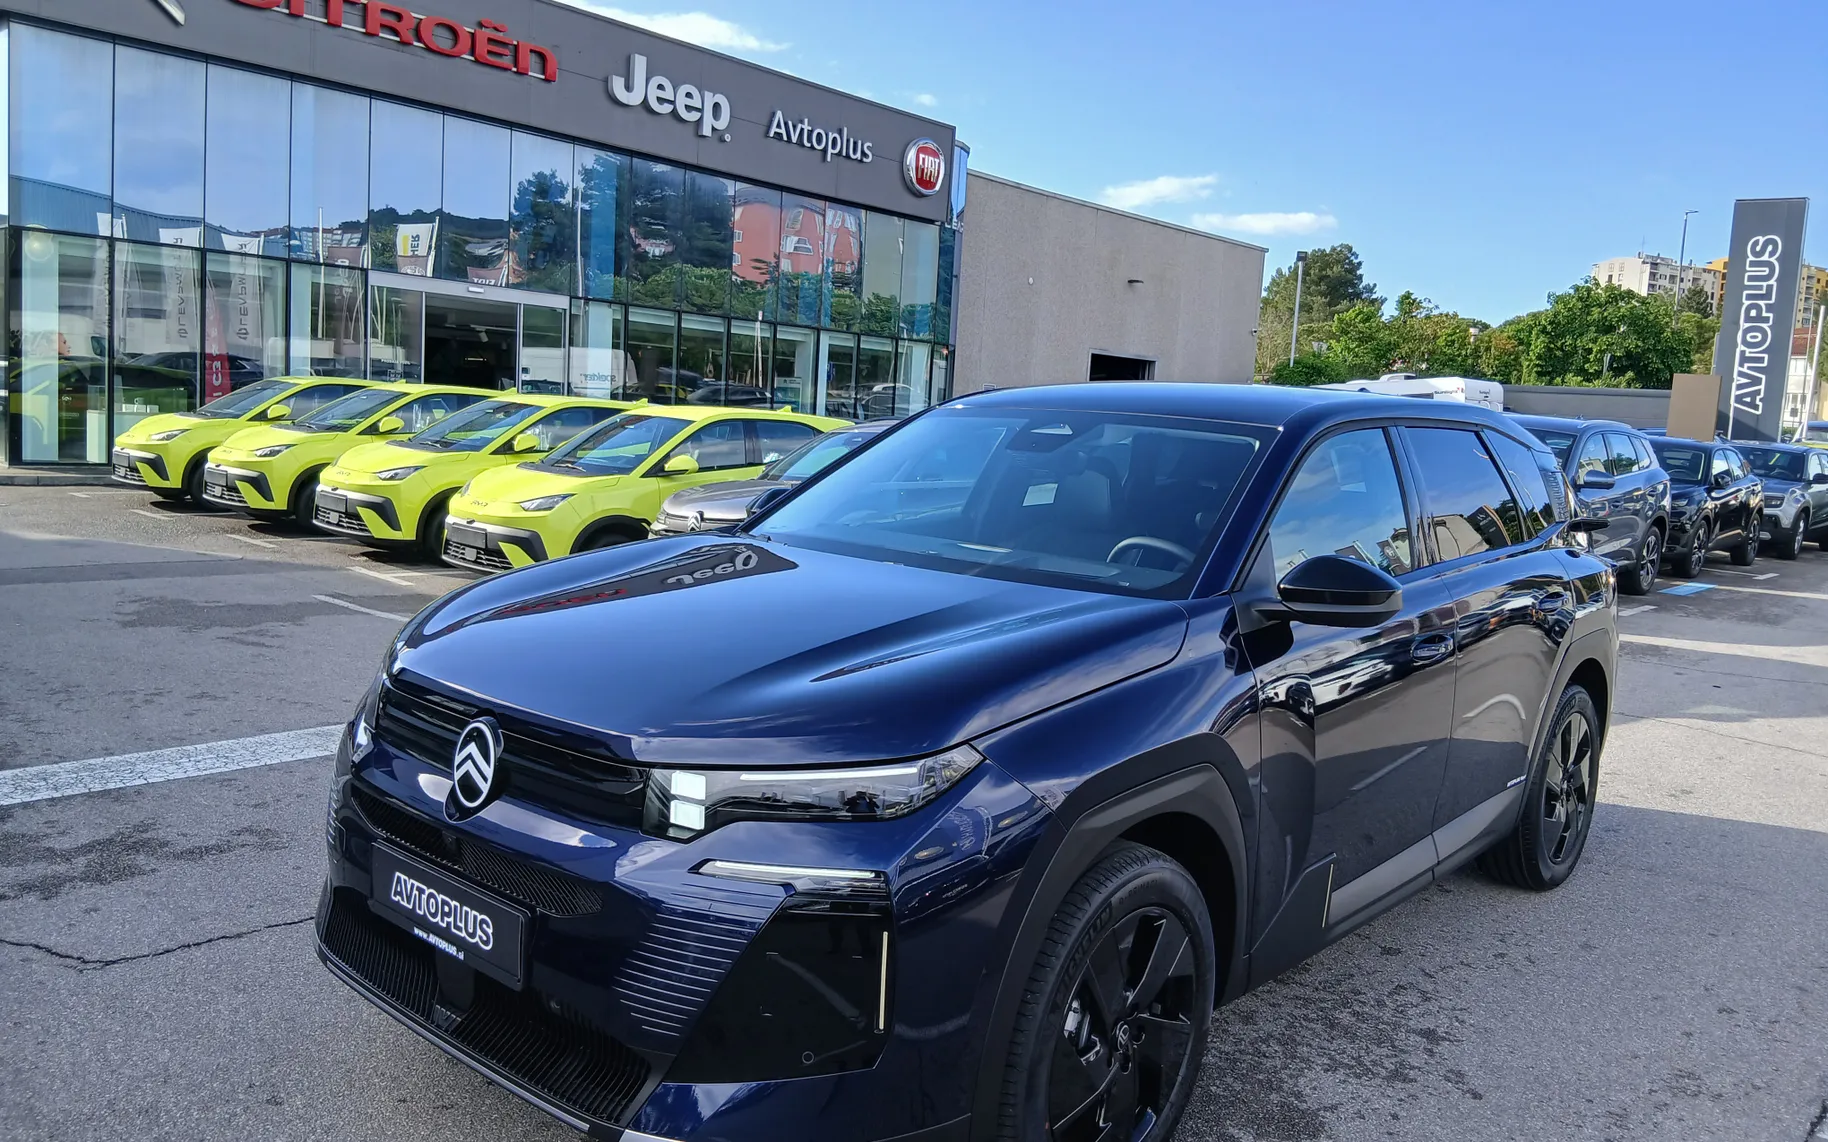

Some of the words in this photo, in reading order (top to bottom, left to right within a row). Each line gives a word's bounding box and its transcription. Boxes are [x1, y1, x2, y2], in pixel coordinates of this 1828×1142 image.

[227, 0, 558, 83] TROËN
[608, 53, 731, 138] Jeep
[766, 110, 873, 163] Avtoplus
[918, 153, 940, 182] FIAT
[1733, 235, 1782, 415] AVTOPLUS
[391, 871, 493, 950] AVTOPLUS
